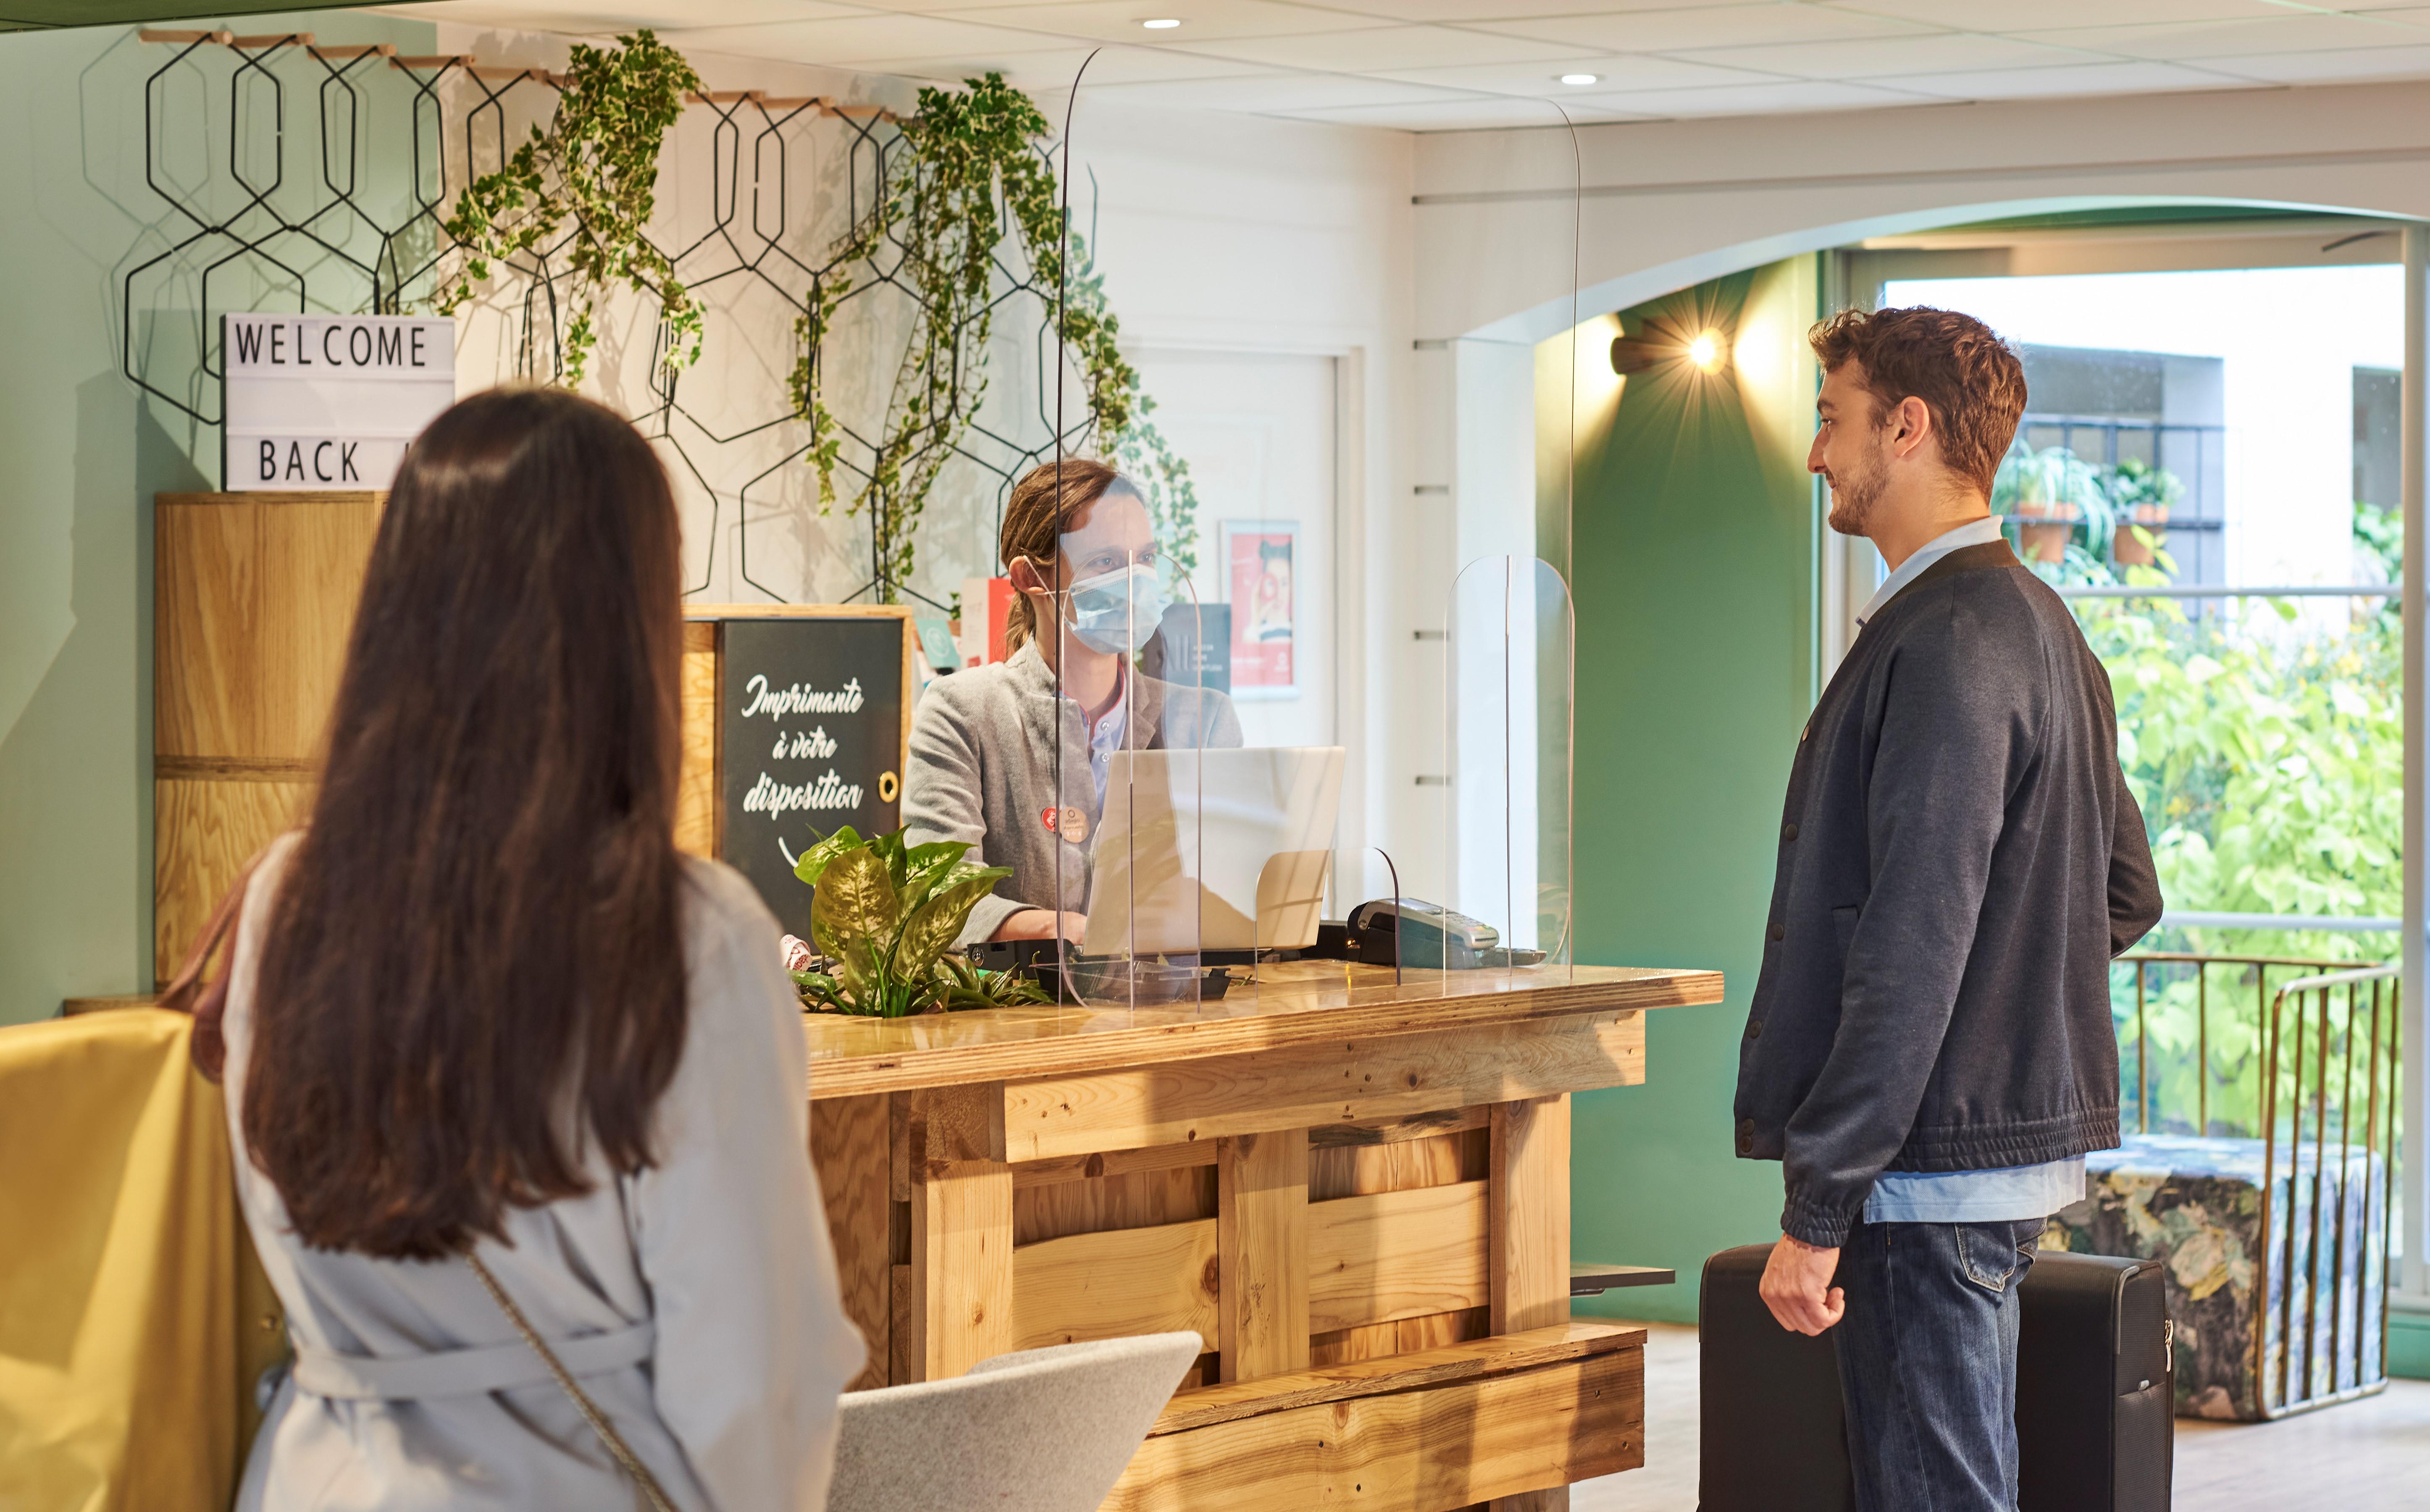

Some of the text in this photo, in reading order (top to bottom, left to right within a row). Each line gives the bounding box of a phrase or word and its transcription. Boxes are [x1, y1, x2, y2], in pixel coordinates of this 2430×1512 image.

[236, 323, 425, 366] WELCOME
[260, 439, 359, 482] BACK
[741, 674, 864, 722] Imprimante
[772, 725, 838, 760] à votre
[743, 768, 864, 821] disposition
